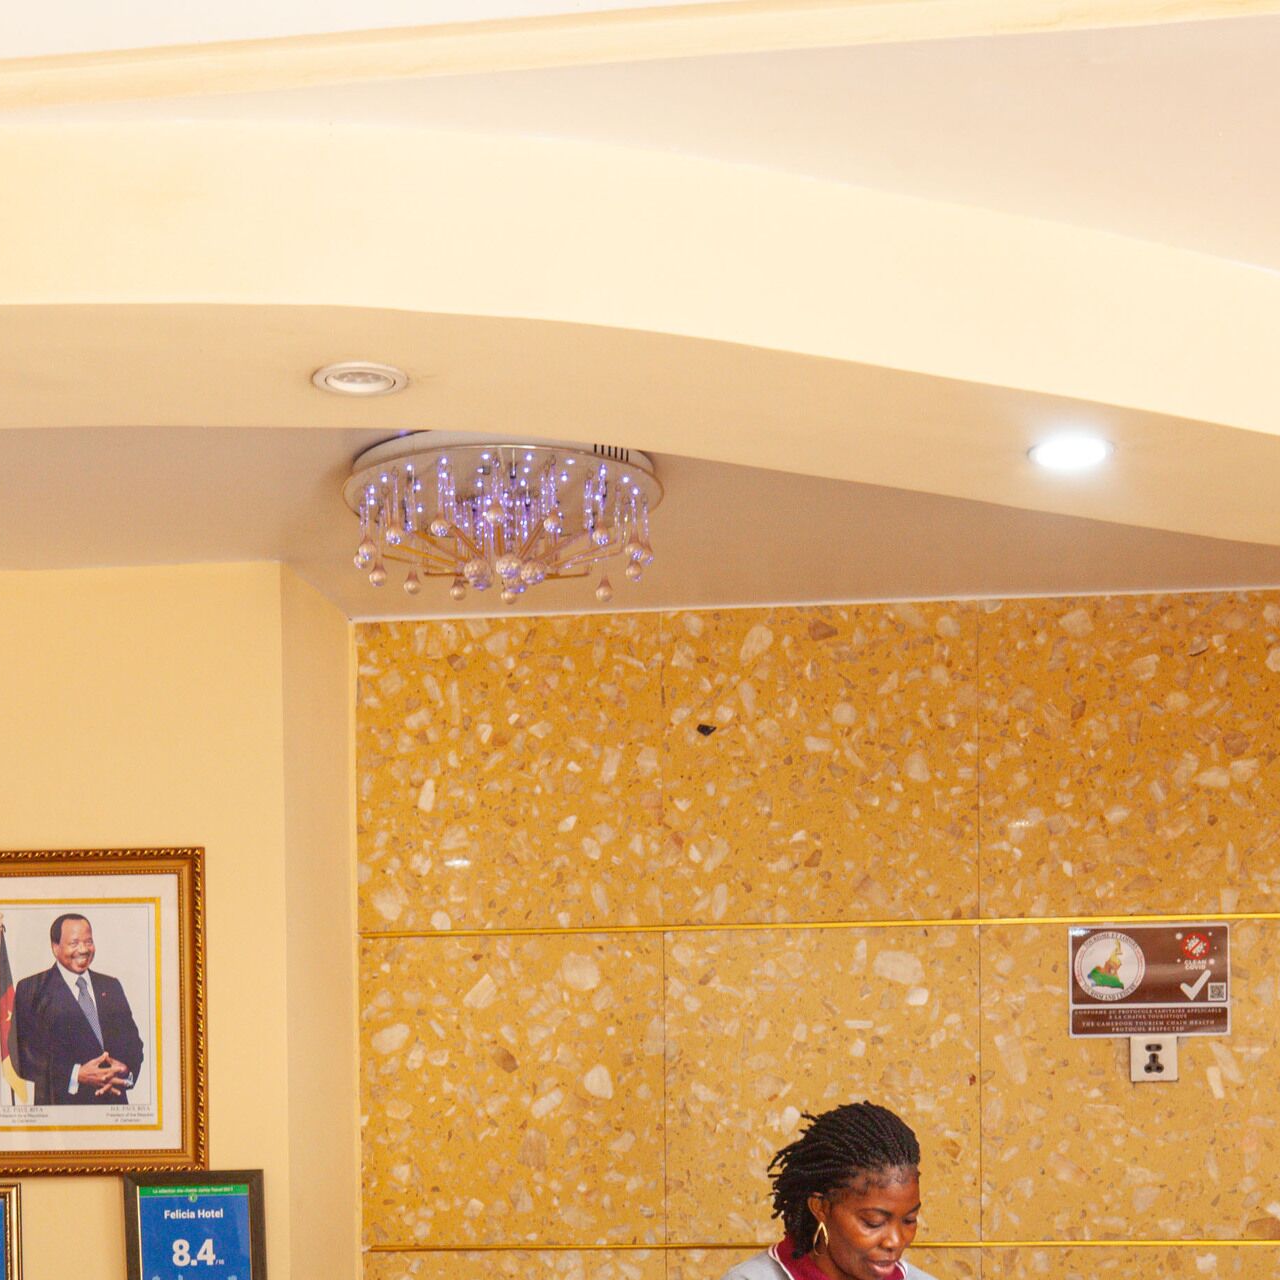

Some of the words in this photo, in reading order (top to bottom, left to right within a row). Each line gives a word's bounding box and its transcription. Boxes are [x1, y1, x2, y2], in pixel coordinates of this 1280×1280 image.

[164, 1209, 196, 1220] Felicia
[197, 1207, 224, 1219] Hotel
[172, 1238, 216, 1267] 8.4
